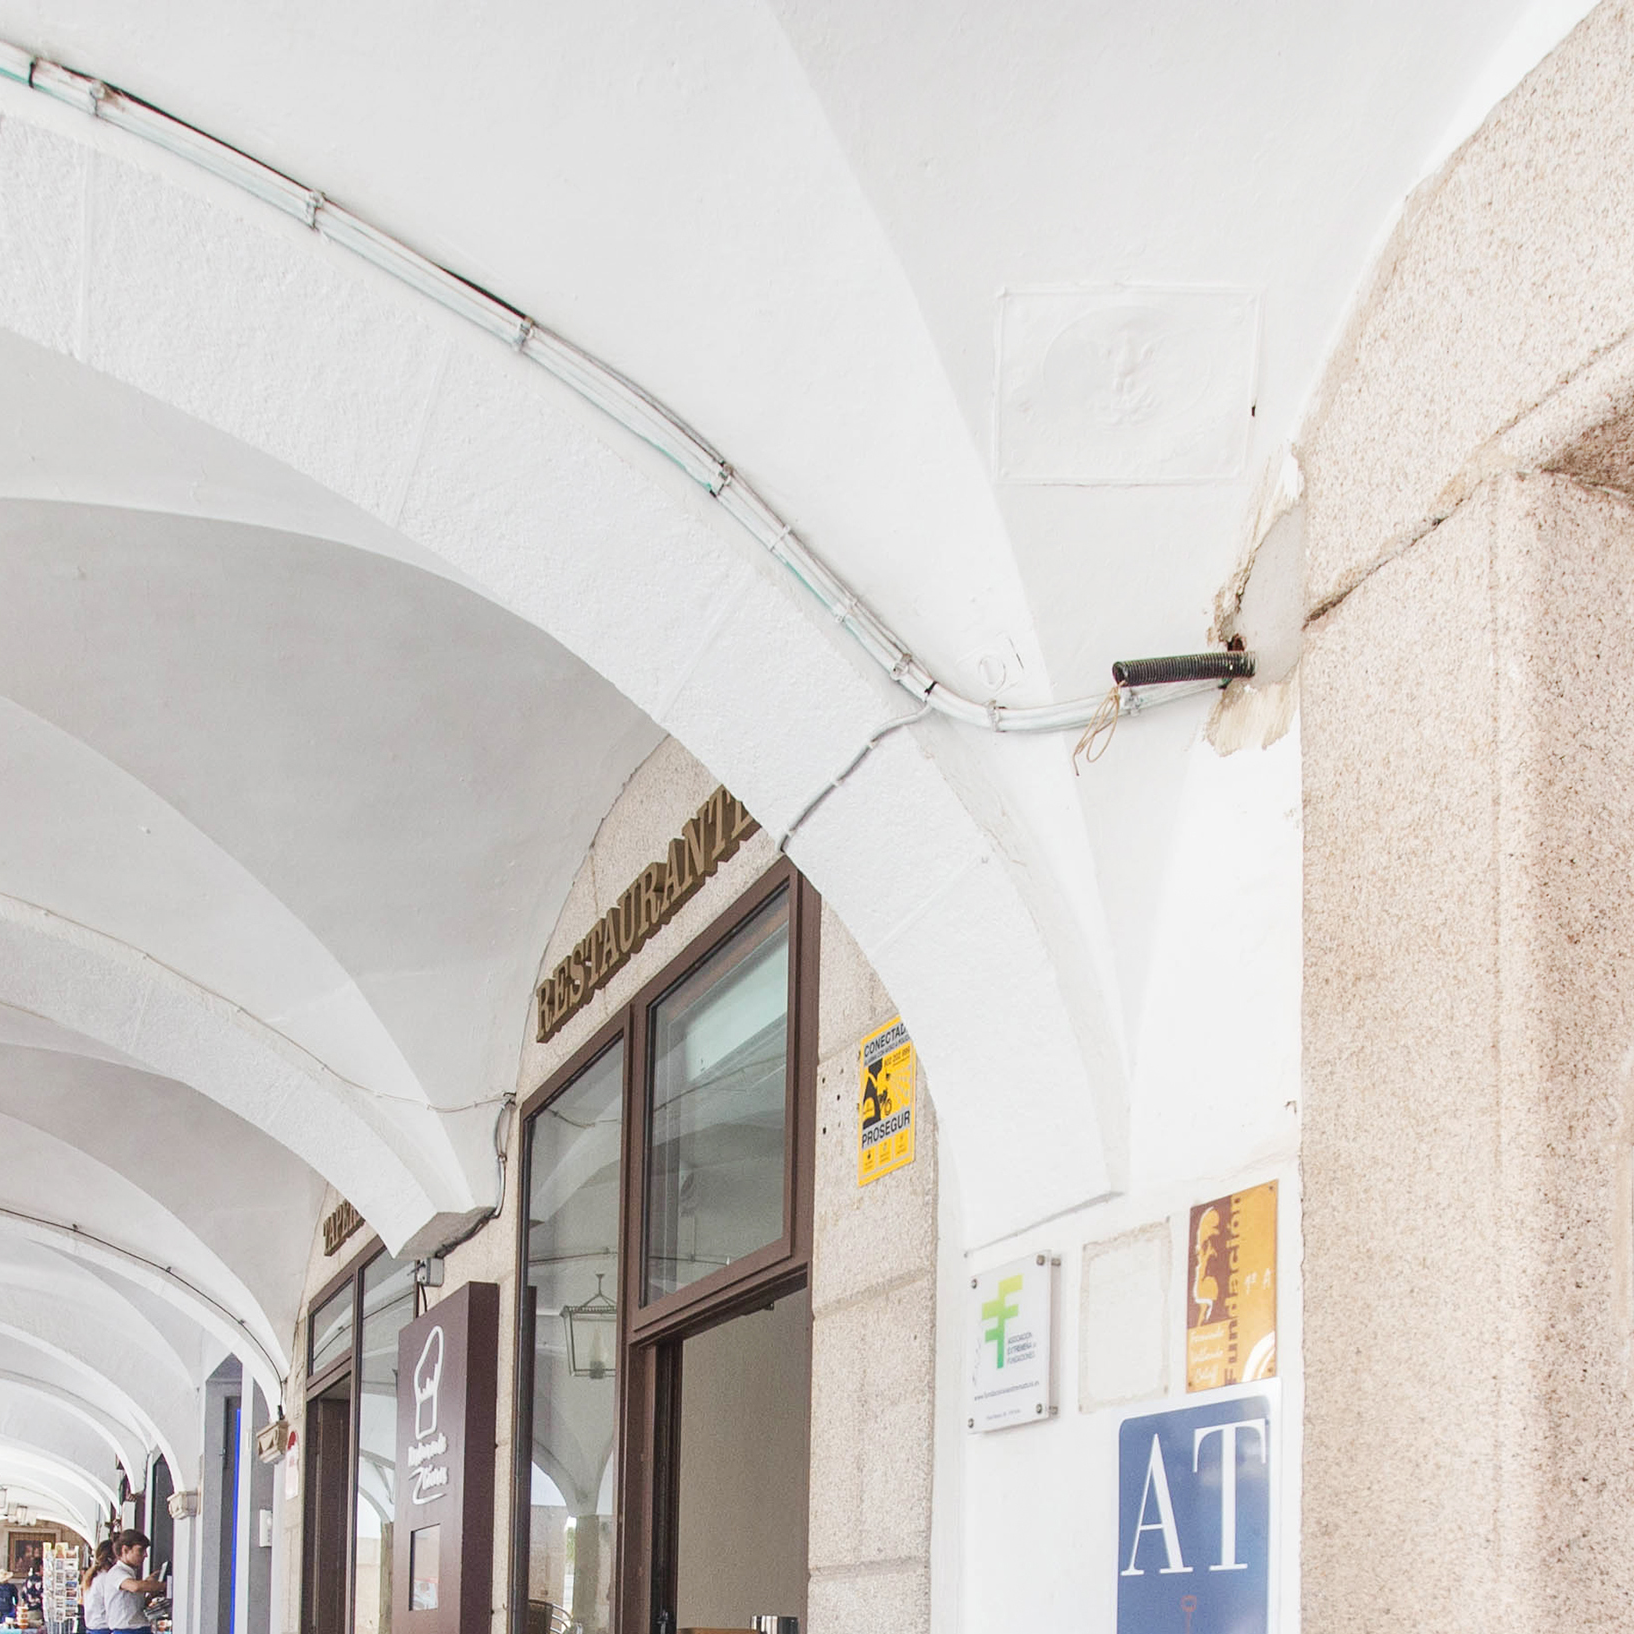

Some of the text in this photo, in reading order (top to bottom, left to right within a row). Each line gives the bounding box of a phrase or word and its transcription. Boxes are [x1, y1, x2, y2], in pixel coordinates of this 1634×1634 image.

[864, 1023, 907, 1058] CONECTAD
[862, 1110, 910, 1149] PROSEGUR
[1121, 1418, 1267, 1577] AT
